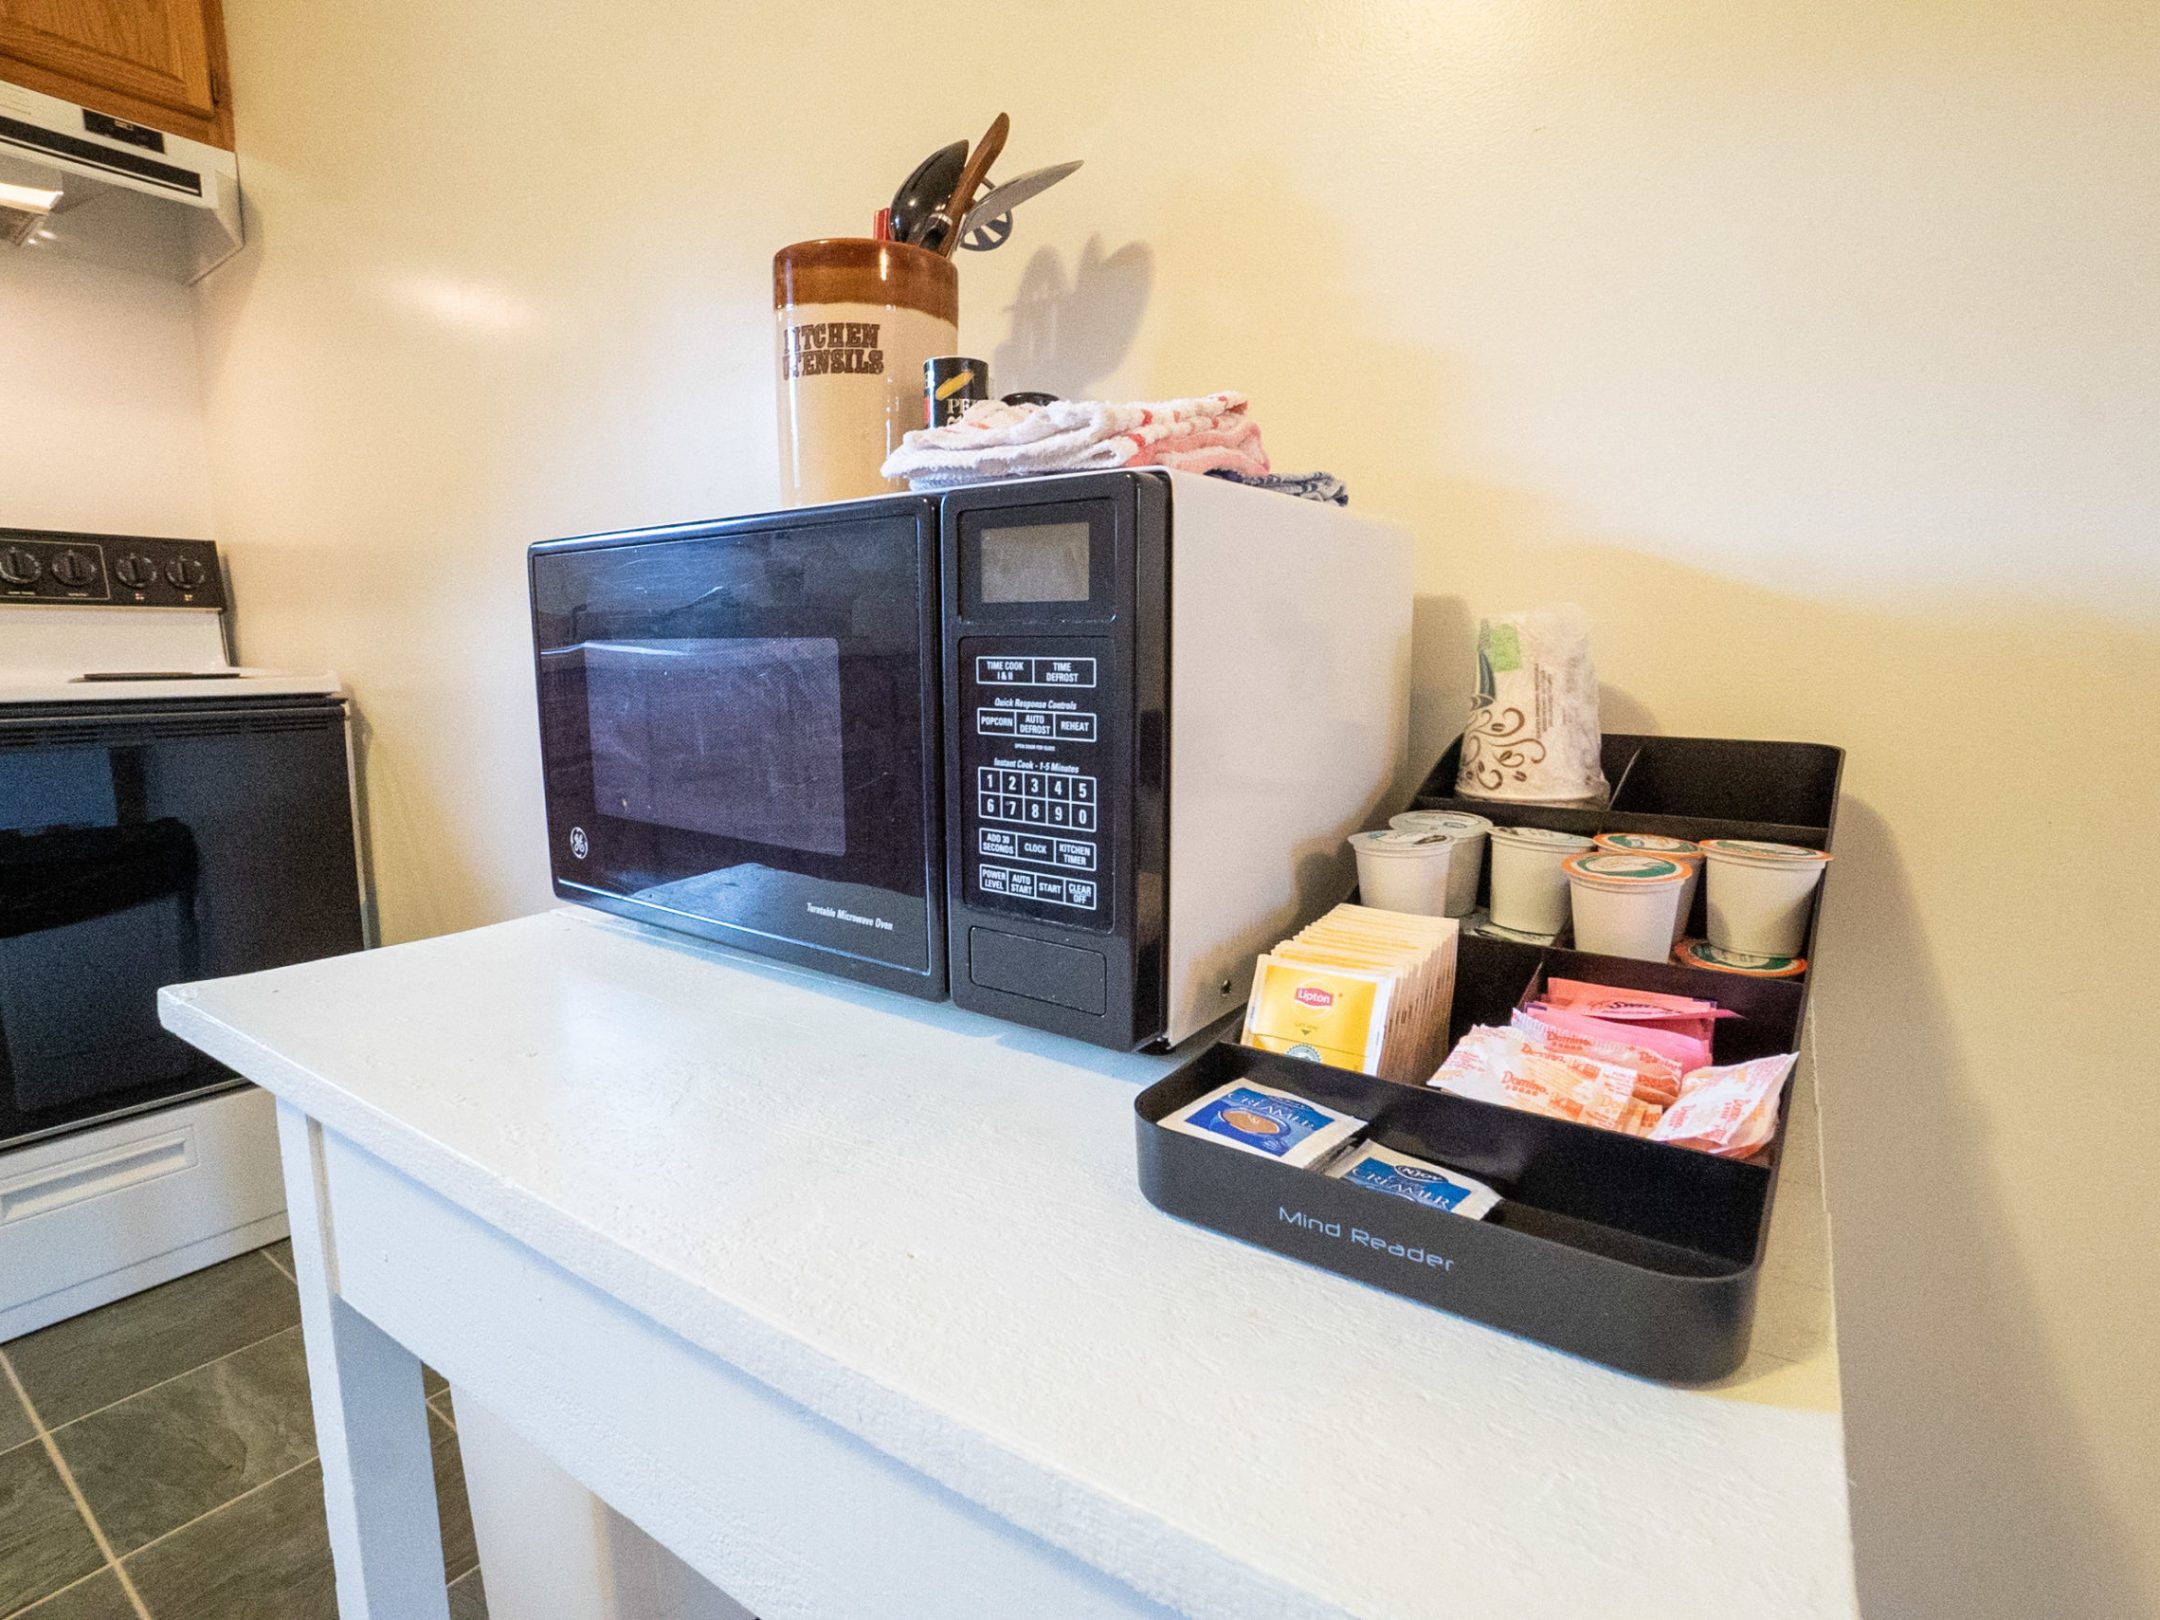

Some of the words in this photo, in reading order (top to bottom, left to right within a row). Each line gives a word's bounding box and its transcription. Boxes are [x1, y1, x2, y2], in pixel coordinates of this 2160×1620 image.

[986, 661, 1003, 671] TIME
[1004, 661, 1024, 671] COOK
[1053, 662, 1071, 672] TIME
[1046, 672, 1079, 682] DEFROST
[994, 697, 1014, 708] Quick
[1014, 698, 1047, 710] Response
[1047, 699, 1077, 711] Controls
[980, 716, 1013, 727] POPCORN
[1025, 714, 1045, 725] AUTO
[1060, 720, 1090, 732] REHEAT
[1019, 723, 1051, 735] DEFROST
[994, 757, 1017, 769] Instant
[1016, 759, 1034, 770] Cook
[1050, 761, 1080, 774] Minutes
[986, 773, 993, 788] 1
[1008, 775, 1017, 791] 2
[1030, 777, 1039, 793] 3
[1054, 780, 1063, 796] 4
[1078, 782, 1087, 799] 5
[986, 798, 995, 813] 6
[1008, 801, 1017, 816] 7
[1031, 803, 1040, 819] 8
[1054, 806, 1063, 821] 9
[1078, 809, 1087, 825] 0
[986, 832, 1001, 844] ADD
[982, 841, 1014, 855] SECONDS
[1024, 842, 1048, 855] CLOCK
[1059, 843, 1091, 857] KITCHEN
[1063, 853, 1087, 866] TIMER
[982, 868, 1007, 881] POWER
[1012, 873, 1031, 885] AUTO
[984, 878, 1004, 890] LEVEL
[1010, 883, 1033, 895] START
[1038, 882, 1062, 894] START
[1068, 883, 1092, 897] CLEAR
[1073, 894, 1087, 904] OFF
[836, 908, 874, 927] Microwave
[874, 917, 893, 931] Oven
[1298, 989, 1331, 1004] Lipton
[1501, 1070, 1547, 1094] Domino
[1278, 1206, 1342, 1239] Mind
[1350, 1227, 1455, 1272] Reader
